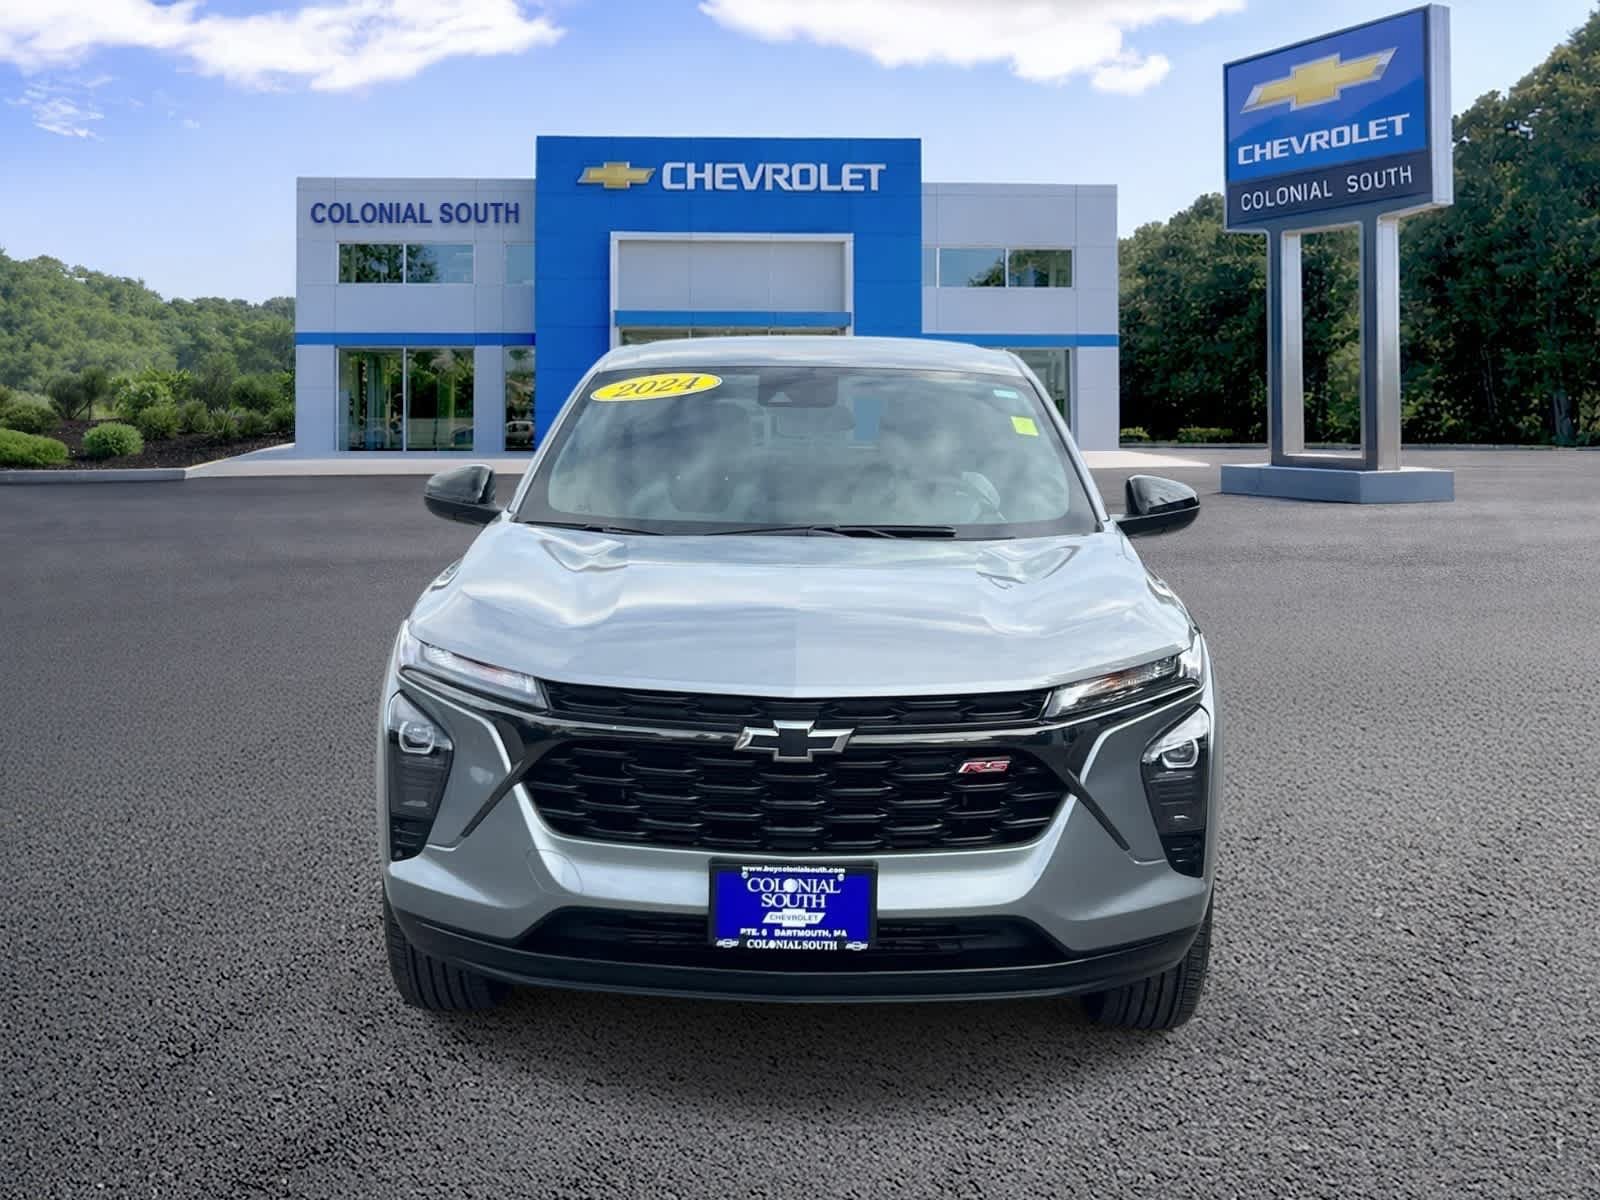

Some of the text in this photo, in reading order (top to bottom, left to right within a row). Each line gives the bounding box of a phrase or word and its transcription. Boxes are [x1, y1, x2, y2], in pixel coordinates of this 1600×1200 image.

[1237, 113, 1410, 165] CHEVROLET
[662, 162, 886, 192] CHEVROLET
[1240, 165, 1413, 211] COLONIAL SOUTH
[310, 202, 520, 225] COLONIAL SOUTH
[611, 376, 701, 398] 2024
[958, 760, 1010, 774] RS
[741, 865, 846, 874] www.buycolonialsouth.com
[746, 877, 841, 894] COLONIAL
[761, 894, 827, 908] SOUTH
[769, 913, 819, 922] CHEVROLET
[774, 929, 832, 938] DARTMOUTH,
[746, 939, 838, 951] COLONIAL SOUTH
